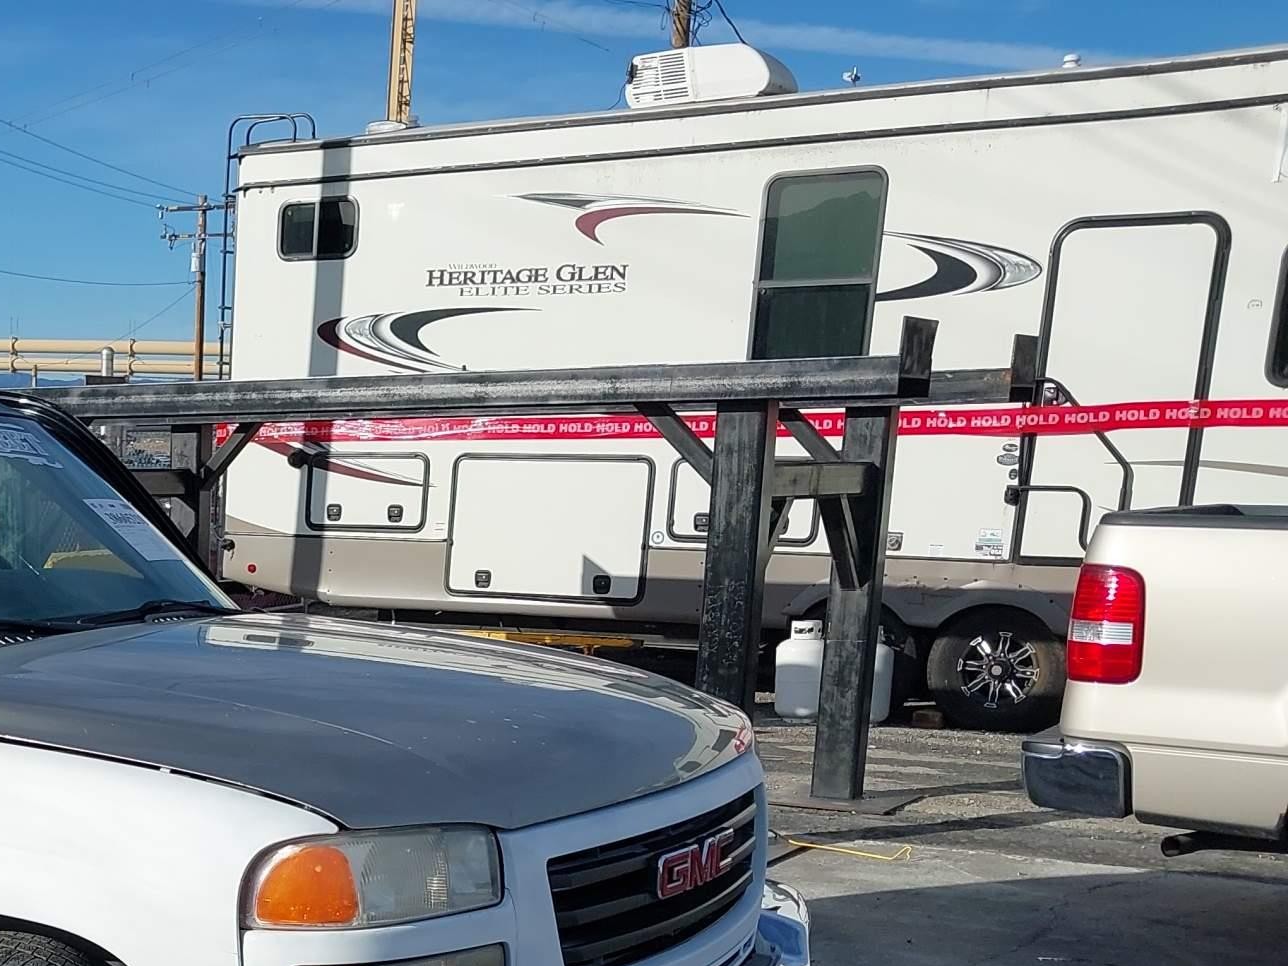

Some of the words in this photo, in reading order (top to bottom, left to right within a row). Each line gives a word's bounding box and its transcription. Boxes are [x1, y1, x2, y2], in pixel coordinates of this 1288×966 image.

[426, 268, 549, 287] HERITAGE
[556, 263, 629, 282] GLEN
[459, 285, 530, 297] ELITE
[537, 282, 626, 296] SERIES
[487, 424, 519, 434] HOLD
[521, 423, 555, 433] HOLD
[559, 422, 592, 433] HOLD
[598, 421, 630, 432] HOLD
[926, 416, 966, 428] HOLD
[971, 415, 1011, 427] HOLD
[1016, 413, 1059, 428] HOLD
[1064, 411, 1109, 424] HOLD
[1115, 408, 1160, 421] HOLD
[1165, 407, 1211, 420] HOLD
[1216, 407, 1263, 419] HOLD
[657, 828, 734, 900] GMC
